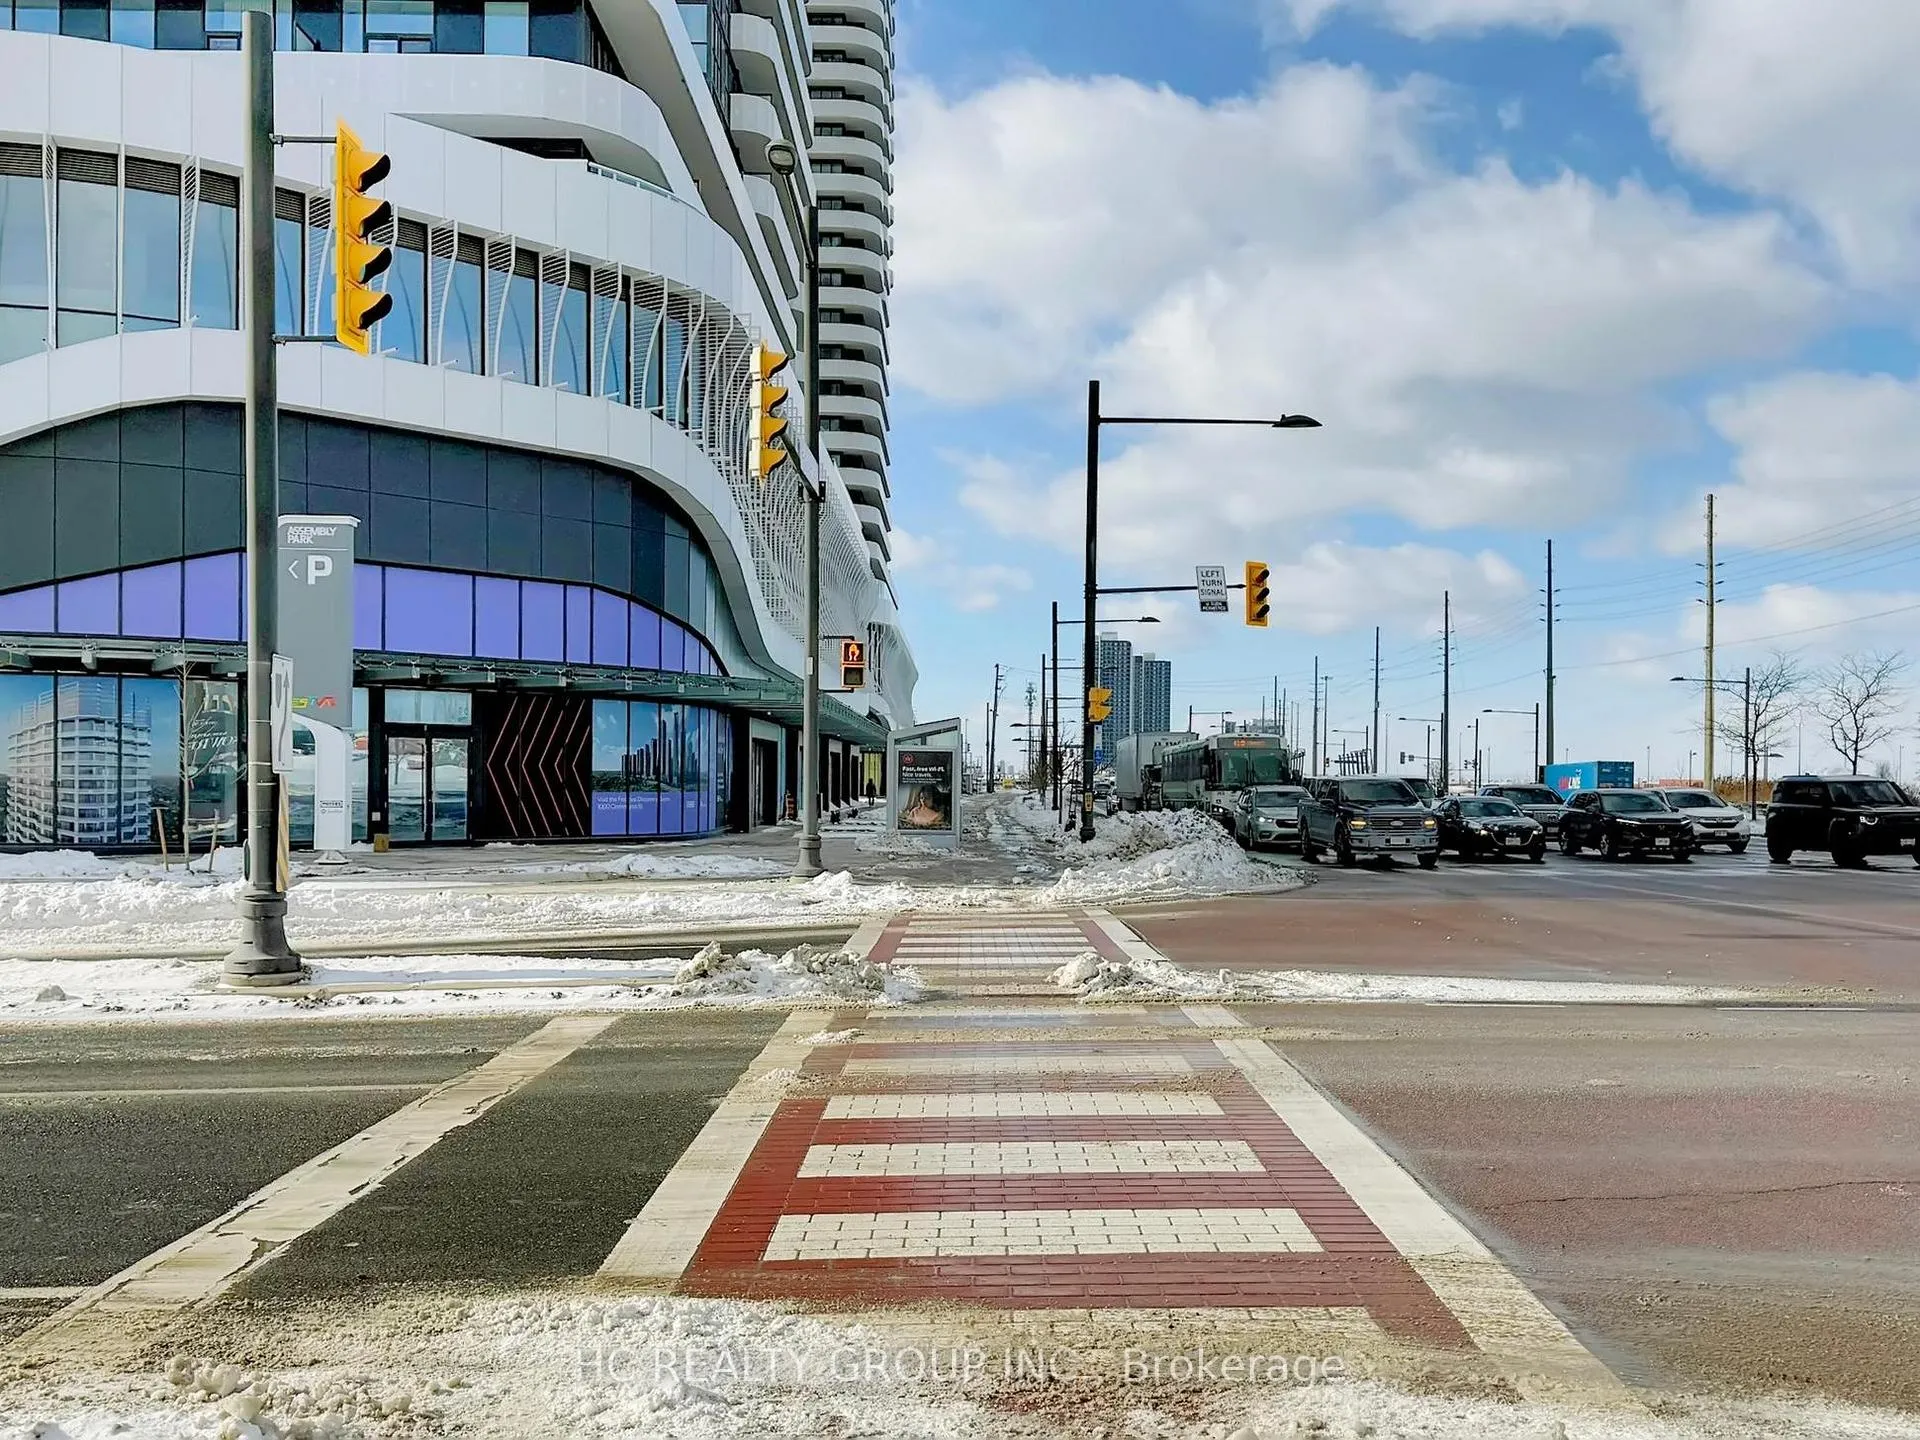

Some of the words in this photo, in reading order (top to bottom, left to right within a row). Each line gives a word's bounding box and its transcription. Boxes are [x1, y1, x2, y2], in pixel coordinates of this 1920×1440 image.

[287, 526, 337, 536] ASSEMBLY
[287, 535, 314, 544] PARK
[308, 554, 333, 585] P
[1201, 570, 1220, 578] LEFT
[1201, 579, 1223, 587] TURN
[1200, 588, 1225, 596] SIGNAL
